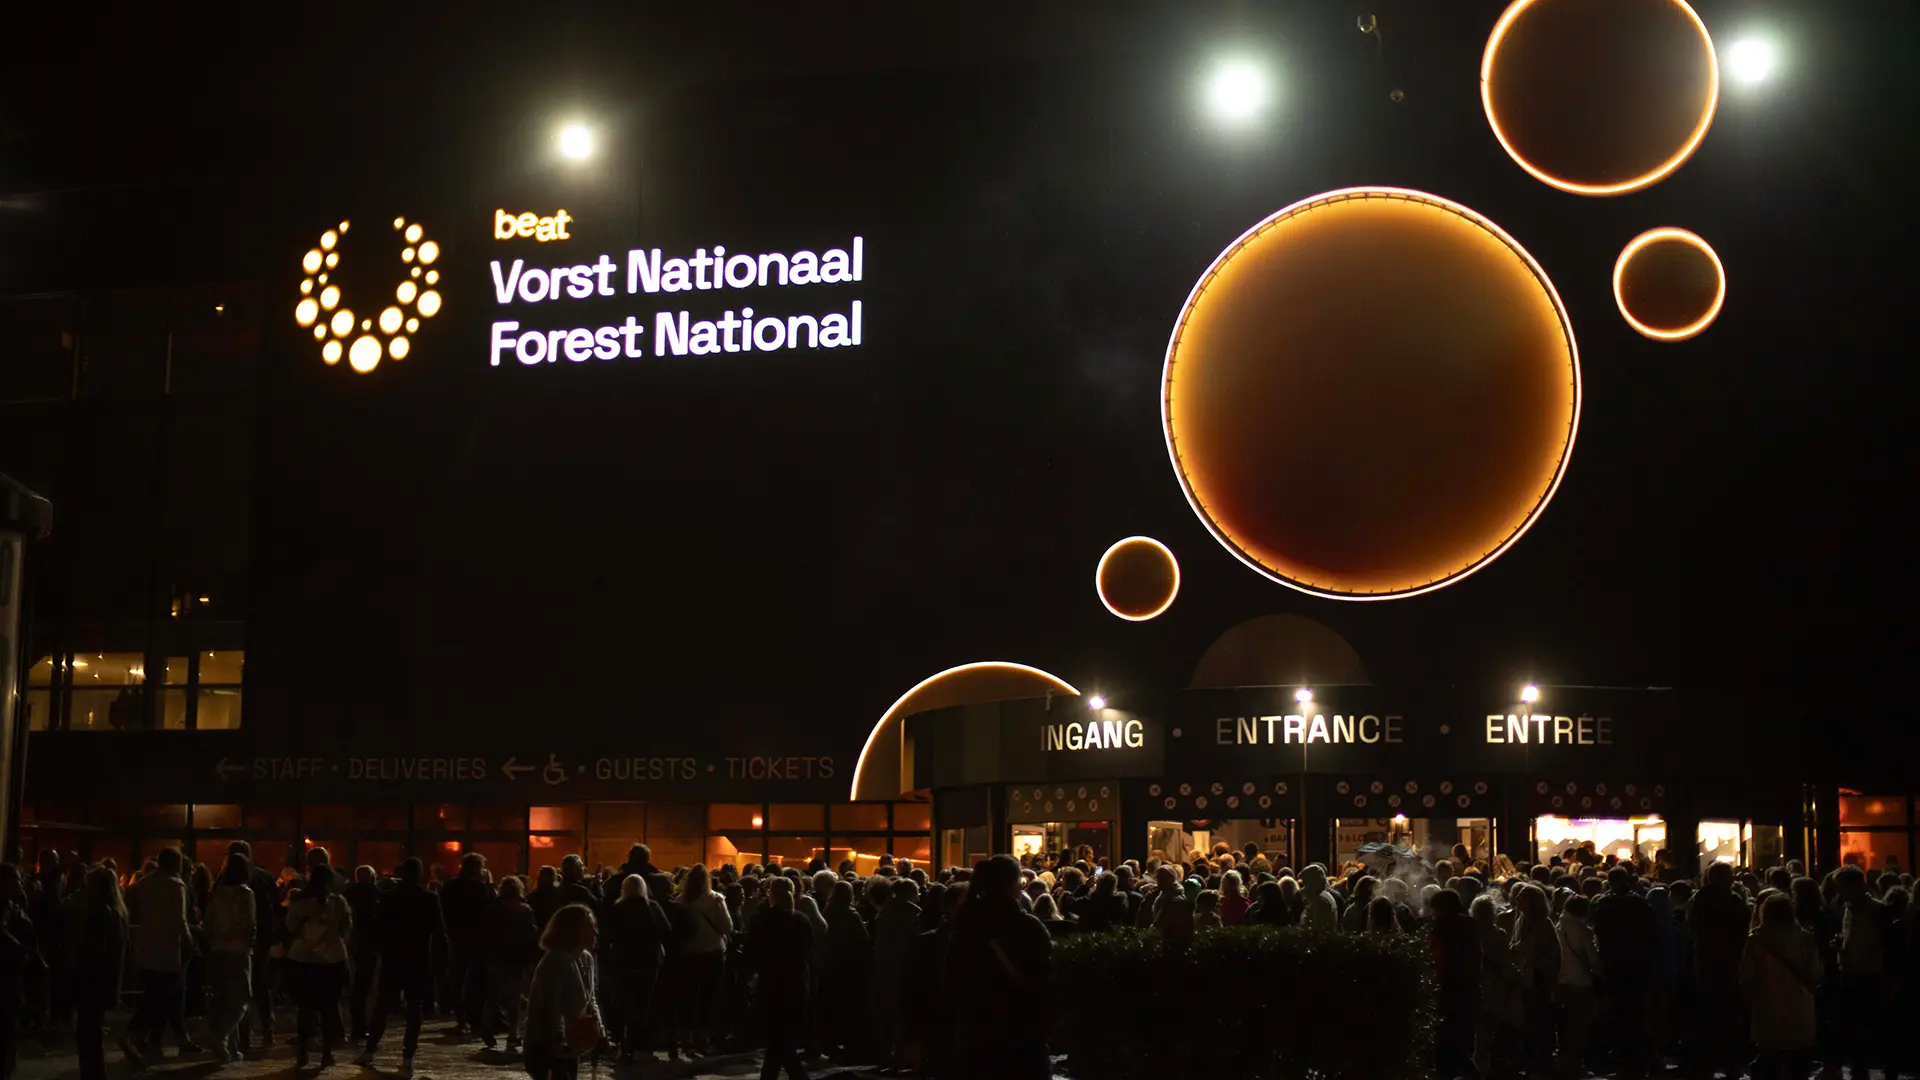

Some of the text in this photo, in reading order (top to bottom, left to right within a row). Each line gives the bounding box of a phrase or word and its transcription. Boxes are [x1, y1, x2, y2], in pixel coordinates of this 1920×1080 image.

[495, 209, 572, 242] beat
[490, 236, 864, 304] Vorst Nationaal
[490, 300, 863, 367] Forest National
[1040, 712, 1614, 751] INGANG ENTRANCE ENTRÉE
[253, 756, 834, 780] STAFF DELIVERIES GUESTS TICKETS
